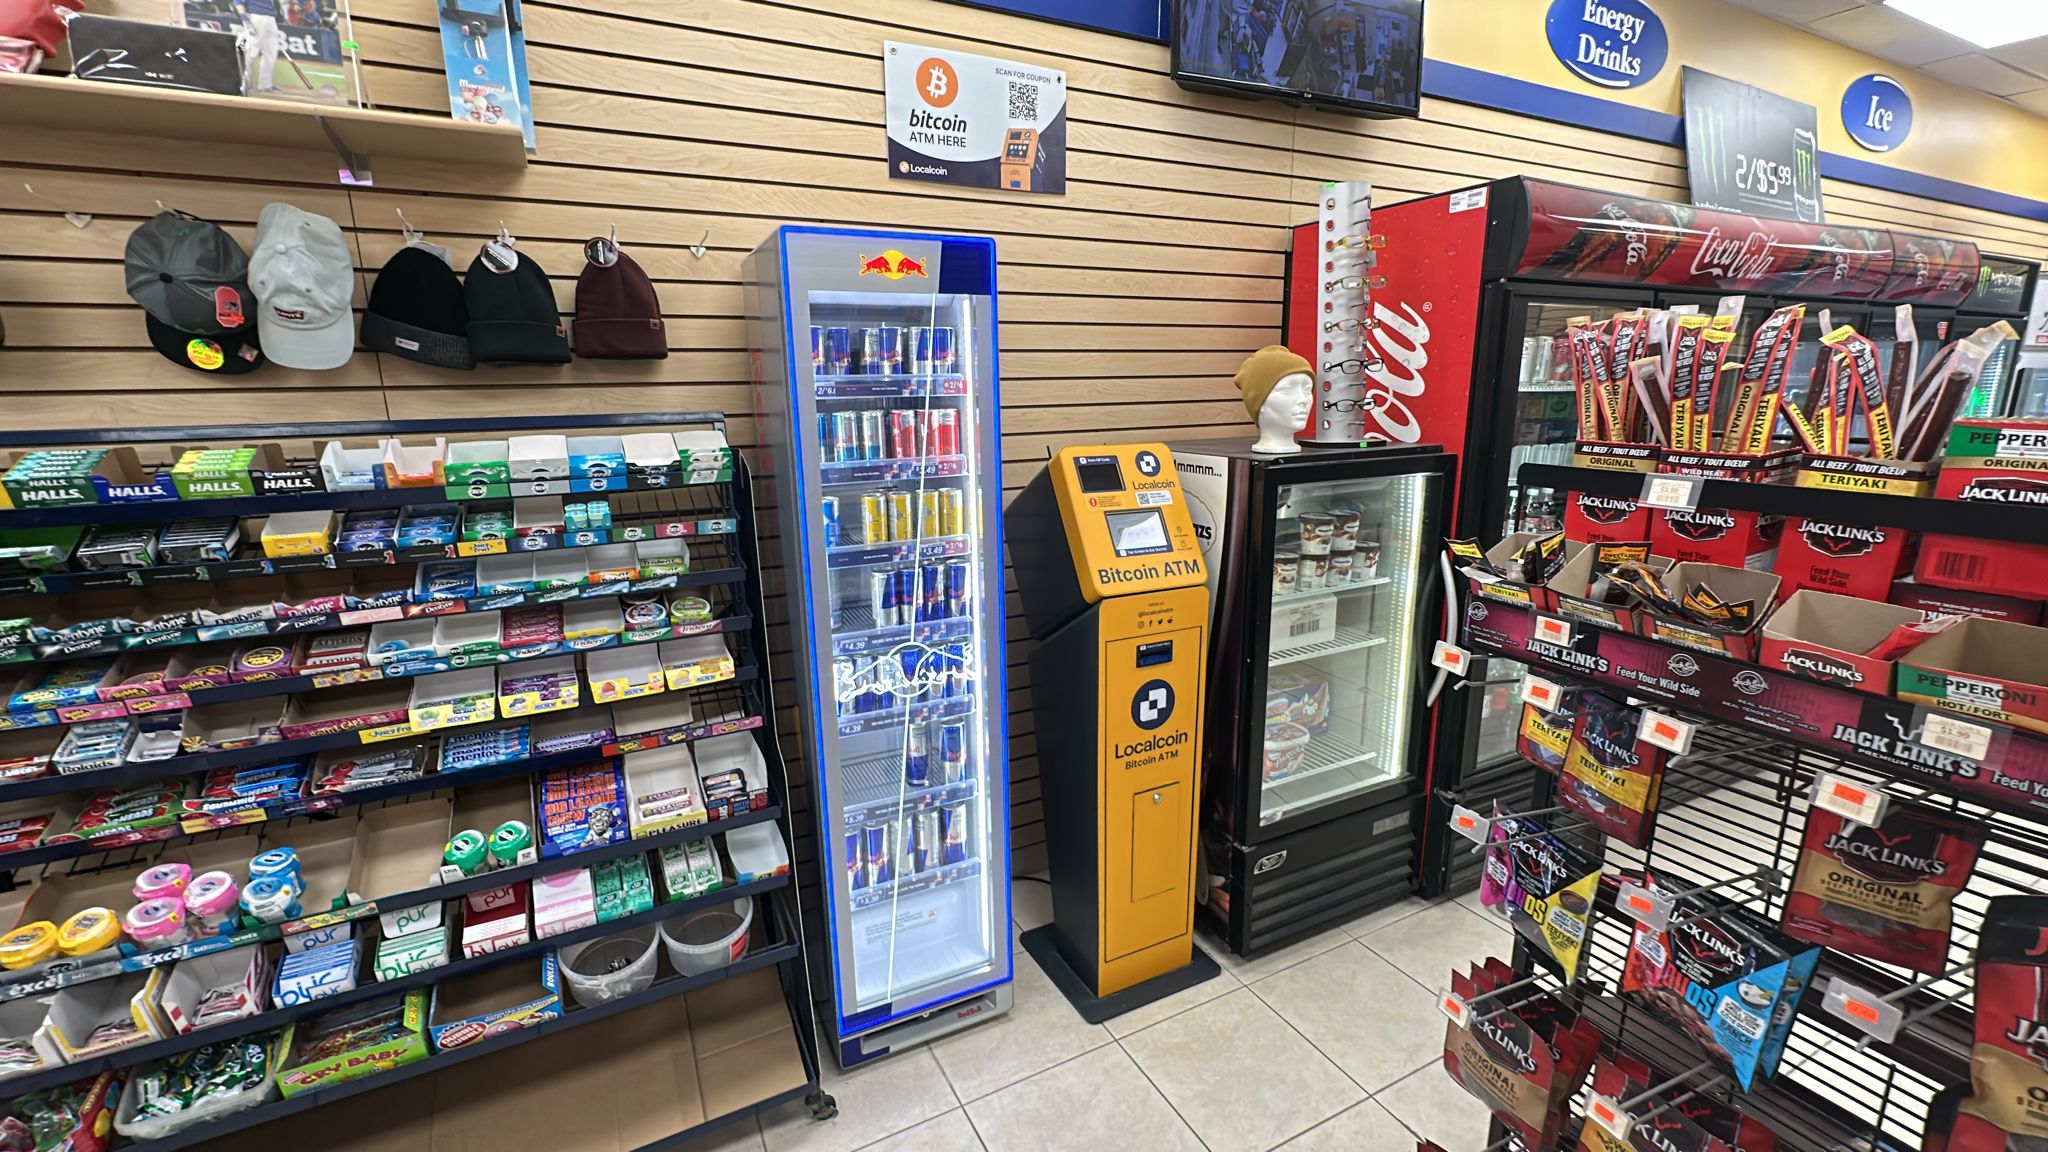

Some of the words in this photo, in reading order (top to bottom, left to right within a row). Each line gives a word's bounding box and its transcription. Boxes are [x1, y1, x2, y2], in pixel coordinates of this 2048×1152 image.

[1582, 0, 1645, 43] Energy
[1576, 33, 1641, 77] Drinks
[995, 67, 1013, 77] SCAN
[1013, 70, 1025, 79] FOR
[1026, 73, 1051, 84] COUPON
[909, 109, 967, 133] bitcoin
[1865, 95, 1893, 132] Ice
[909, 131, 935, 144] ATM
[937, 134, 967, 147] HERE
[910, 163, 948, 176] Localcoin
[1583, 383, 1592, 425] ORIGINAL
[1604, 384, 1620, 428] ORIGINAL
[1730, 385, 1752, 437] ORIGINAL
[1676, 402, 1685, 450] TERIYAKI
[1750, 399, 1770, 449] TERIYAKI
[1592, 446, 1608, 454] BEEF
[1612, 448, 1628, 456] TOUT
[1589, 457, 1635, 468] ORIGINAL
[1667, 455, 1679, 463] ALL
[1680, 456, 1699, 464] BEEF
[1704, 457, 1723, 466] TOUT
[1810, 460, 1827, 469] ALL
[1828, 461, 1849, 471] BEEF
[1854, 464, 1878, 474] TOUT
[1703, 469, 1724, 477] HEAT
[1821, 474, 1888, 489] TERIYAKI
[29, 478, 69, 488] HALLS
[108, 485, 167, 498] HALLS
[189, 481, 243, 493] HALLS
[264, 477, 315, 490] HALLS
[1132, 479, 1176, 490] Localcoin
[22, 488, 85, 501] HALLS
[1576, 493, 1603, 507] JACK
[1958, 485, 2007, 502] JACK
[1663, 509, 1695, 524] JACK
[1798, 519, 1835, 537] JACK
[643, 558, 677, 566] Trident
[1810, 564, 1830, 577] Feed
[1098, 563, 1160, 585] Bitcoin
[1163, 559, 1201, 577] ATM
[428, 579, 469, 592] Trident
[288, 599, 335, 617] Dentyne
[425, 601, 455, 614] Dentyne
[134, 615, 188, 634] Dentyne
[215, 609, 263, 625] Dentyne
[294, 615, 327, 629] Dentyne
[51, 623, 107, 643] Dentyne
[227, 621, 266, 636] Dentyne
[64, 638, 102, 654] Dentyne
[145, 630, 183, 645] Dentyne
[572, 638, 607, 648] Trident
[514, 648, 543, 657] Trident
[1526, 638, 1560, 659] JACK
[1562, 646, 1609, 672] LINK'S
[1541, 655, 1571, 669] PREMIUM
[1780, 652, 1818, 672] JACK
[1616, 665, 1637, 680] Feed
[1638, 671, 1658, 685] Your
[1659, 676, 1679, 691] Wild
[1680, 682, 1701, 698] Side
[1916, 673, 2037, 706] PEPPERONI
[1936, 699, 1966, 710] HOT
[1973, 706, 2013, 721] FORT
[453, 730, 500, 743] mentos
[1114, 729, 1189, 760] Localcoin
[452, 750, 501, 764] mentos
[1125, 755, 1156, 770] Bitcoin
[1158, 749, 1179, 762] ATM
[1832, 724, 1889, 753] JACK
[1893, 741, 1980, 779] LINK'S
[62, 760, 116, 775] Rolaids
[1580, 755, 1626, 787] TERIYAKI
[1858, 748, 1910, 768] PREMIUM
[1912, 764, 1945, 778] CUTS
[1992, 770, 2030, 792] Feed
[544, 801, 568, 816] BIG
[569, 792, 617, 811] LEAGUE
[546, 810, 586, 827] CHEW
[649, 818, 703, 836] PLEASURE
[1824, 834, 1881, 861] JACK
[1828, 872, 1923, 905] ORIGINAL
[9, 972, 65, 996] excel
[441, 1023, 486, 1045] DUBBLE
[300, 1061, 341, 1086] CRY
[1464, 1042, 1517, 1096] ORIGINAL
